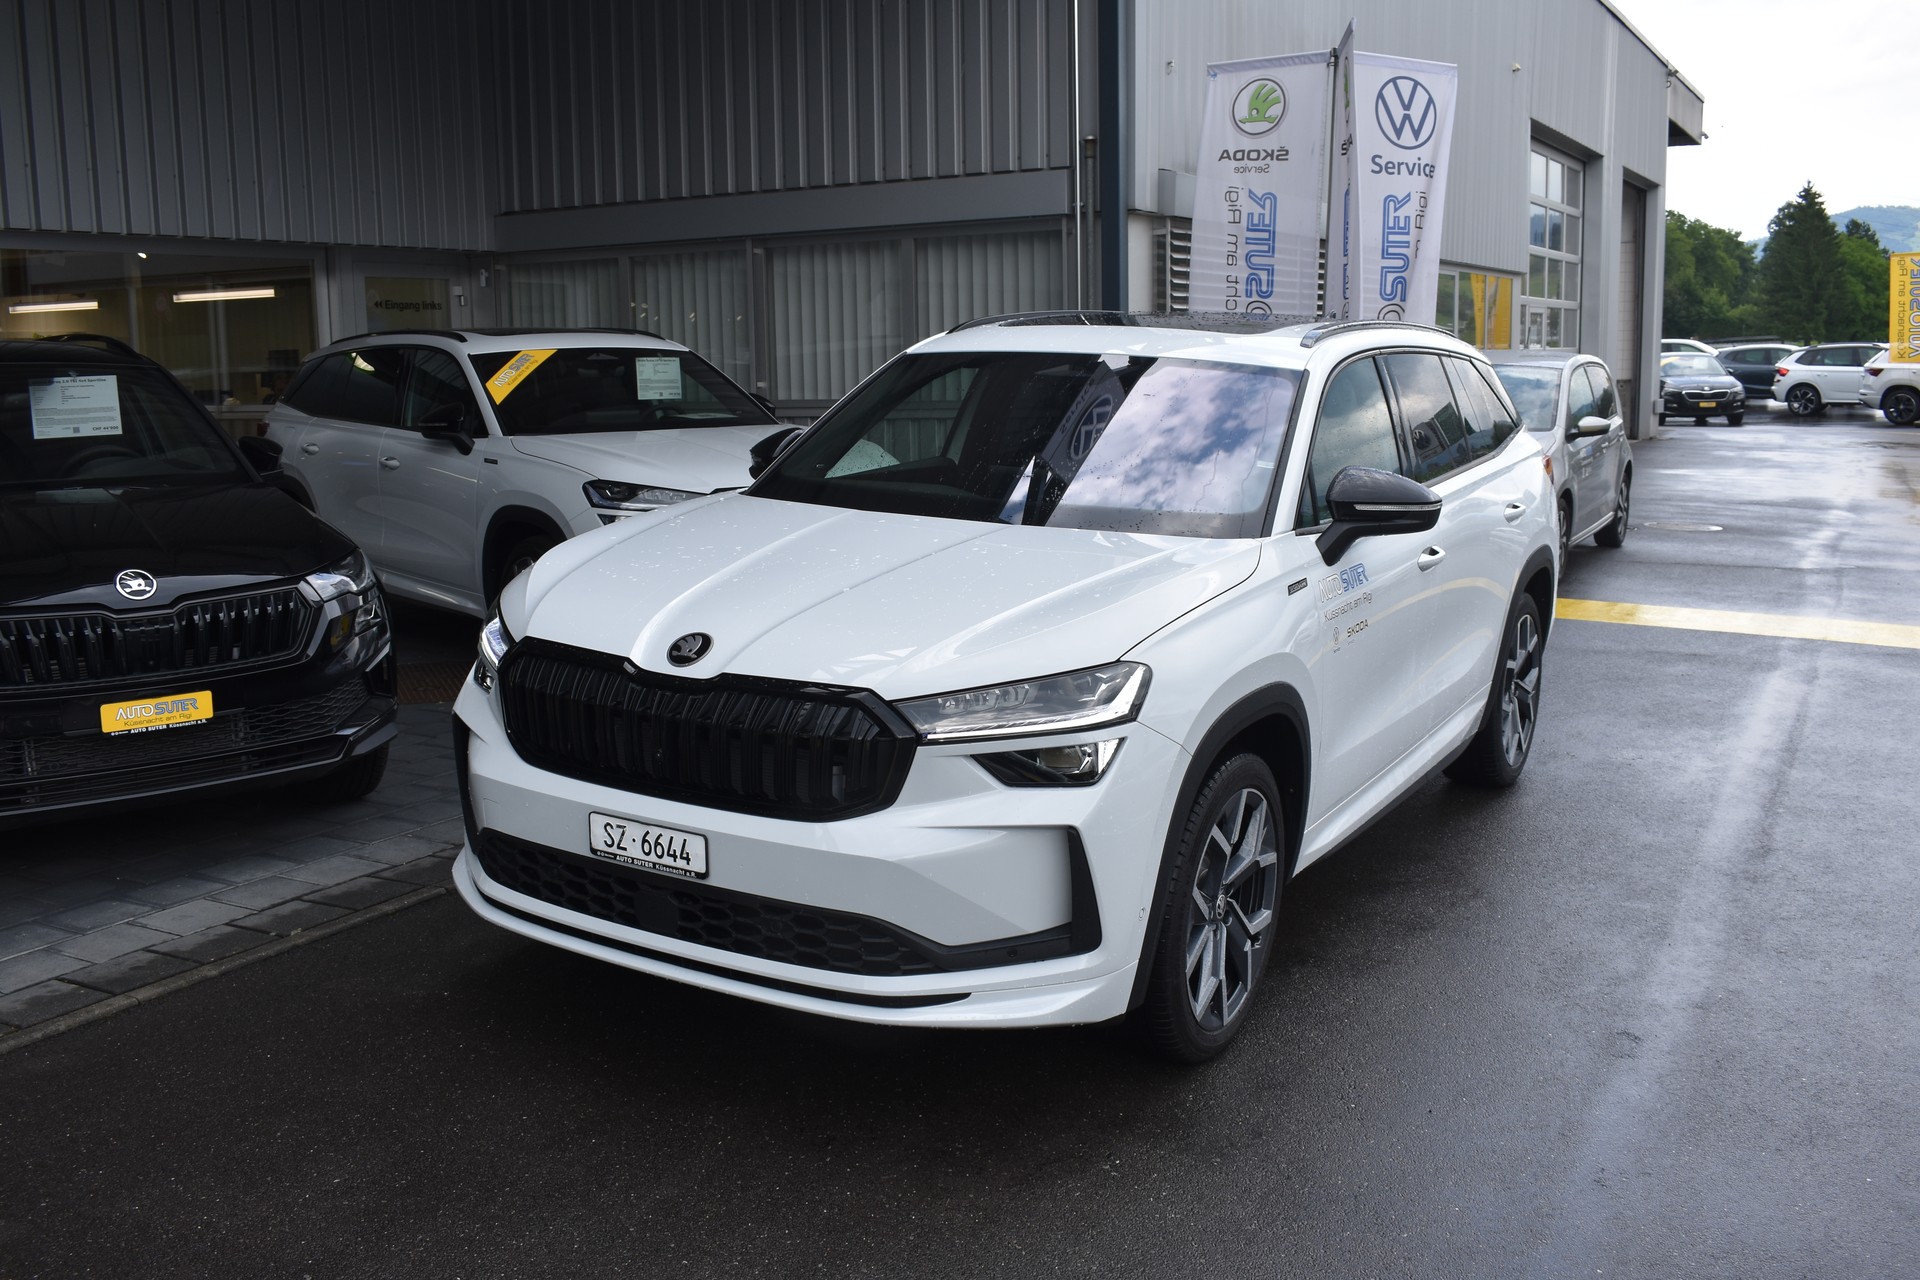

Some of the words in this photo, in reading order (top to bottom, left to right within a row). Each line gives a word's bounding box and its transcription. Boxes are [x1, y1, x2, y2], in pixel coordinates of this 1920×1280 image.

[1370, 154, 1435, 179] Service
[385, 299, 420, 312] Eingang
[422, 300, 442, 310] links
[124, 716, 164, 727] Küssnacht
[166, 714, 177, 722] am
[615, 854, 632, 864] AUTO
[633, 858, 653, 869] SUTER
[655, 863, 685, 876] Küssnacht
